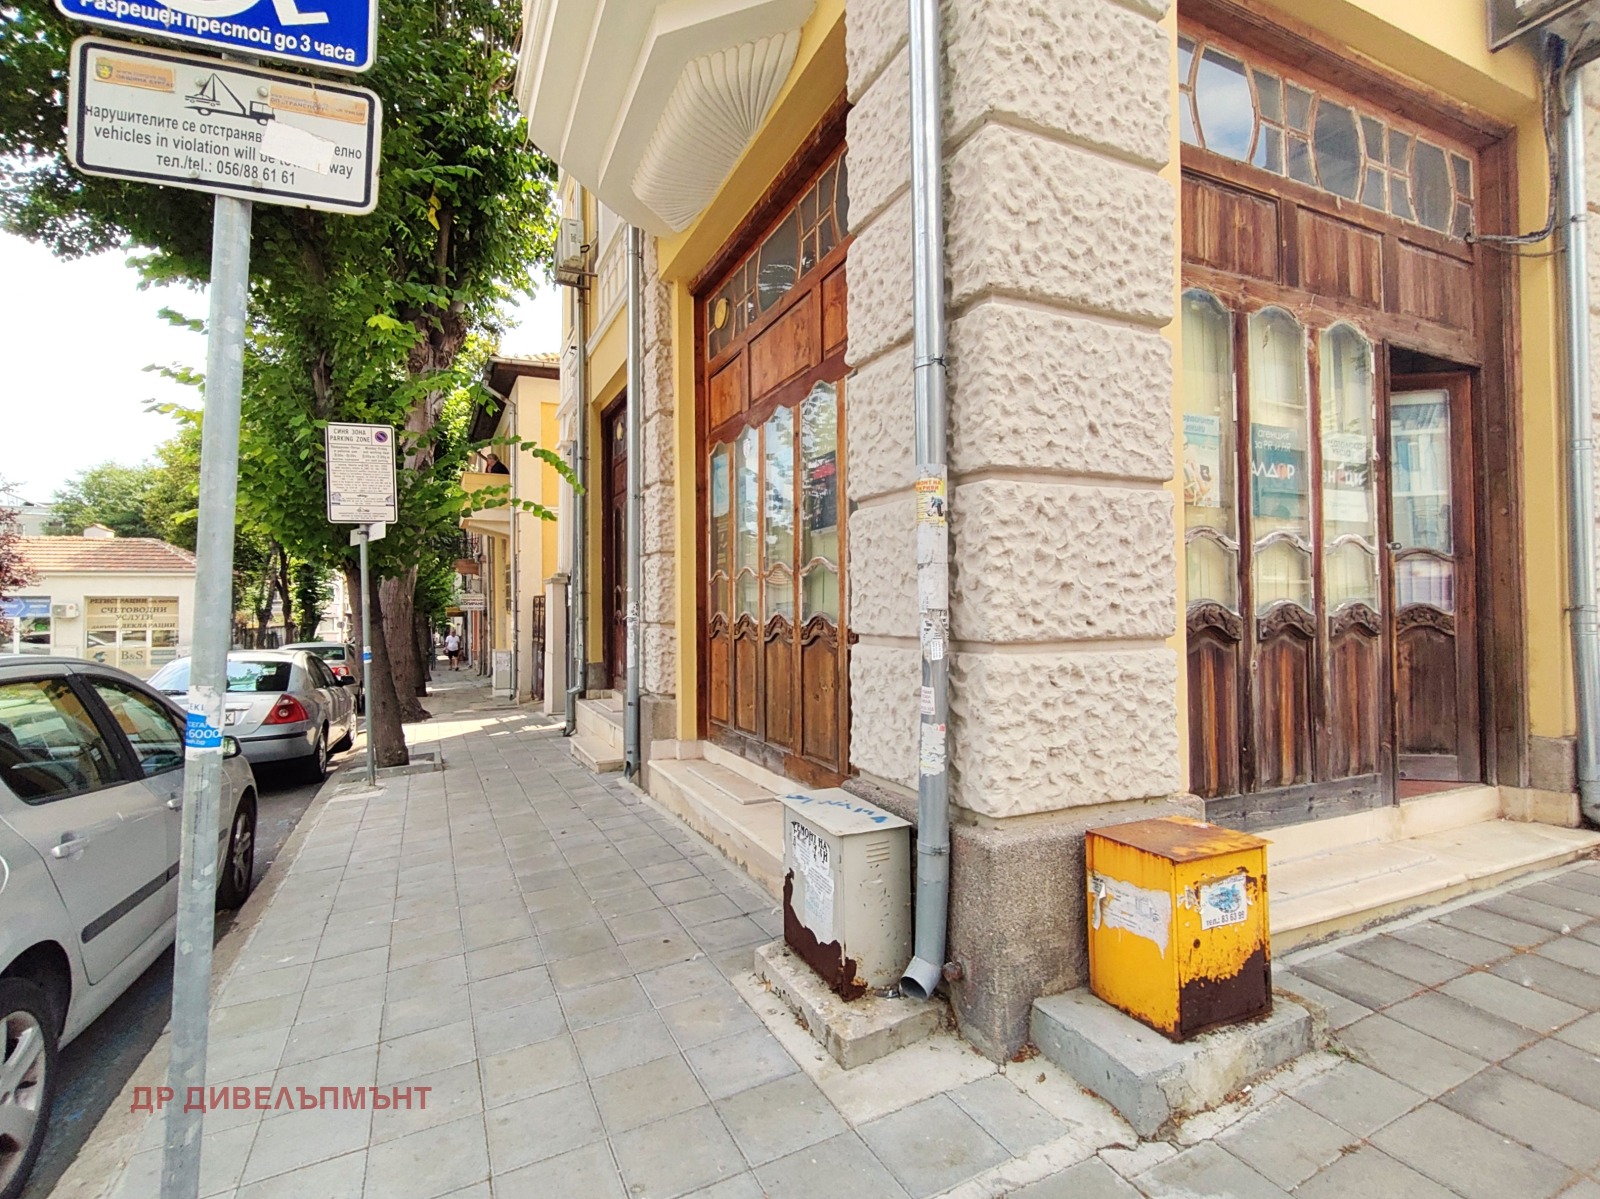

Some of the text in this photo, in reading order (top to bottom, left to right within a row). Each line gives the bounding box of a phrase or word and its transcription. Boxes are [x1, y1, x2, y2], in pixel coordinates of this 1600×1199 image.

[186, 14, 271, 44] престой
[274, 34, 297, 51] до
[300, 34, 311, 52] 3
[314, 41, 355, 62] часа
[85, 105, 262, 143] нарушителите се отстраняв
[94, 125, 152, 145] vehicles
[156, 132, 168, 148] in
[173, 136, 229, 157] violation
[234, 146, 256, 161] will
[216, 160, 258, 179] 056/88
[262, 167, 276, 182] 61
[281, 170, 295, 185] 61
[329, 163, 354, 180] way
[101, 606, 167, 614] СЧЕТОВОДНИ
[121, 650, 144, 660] B&S
